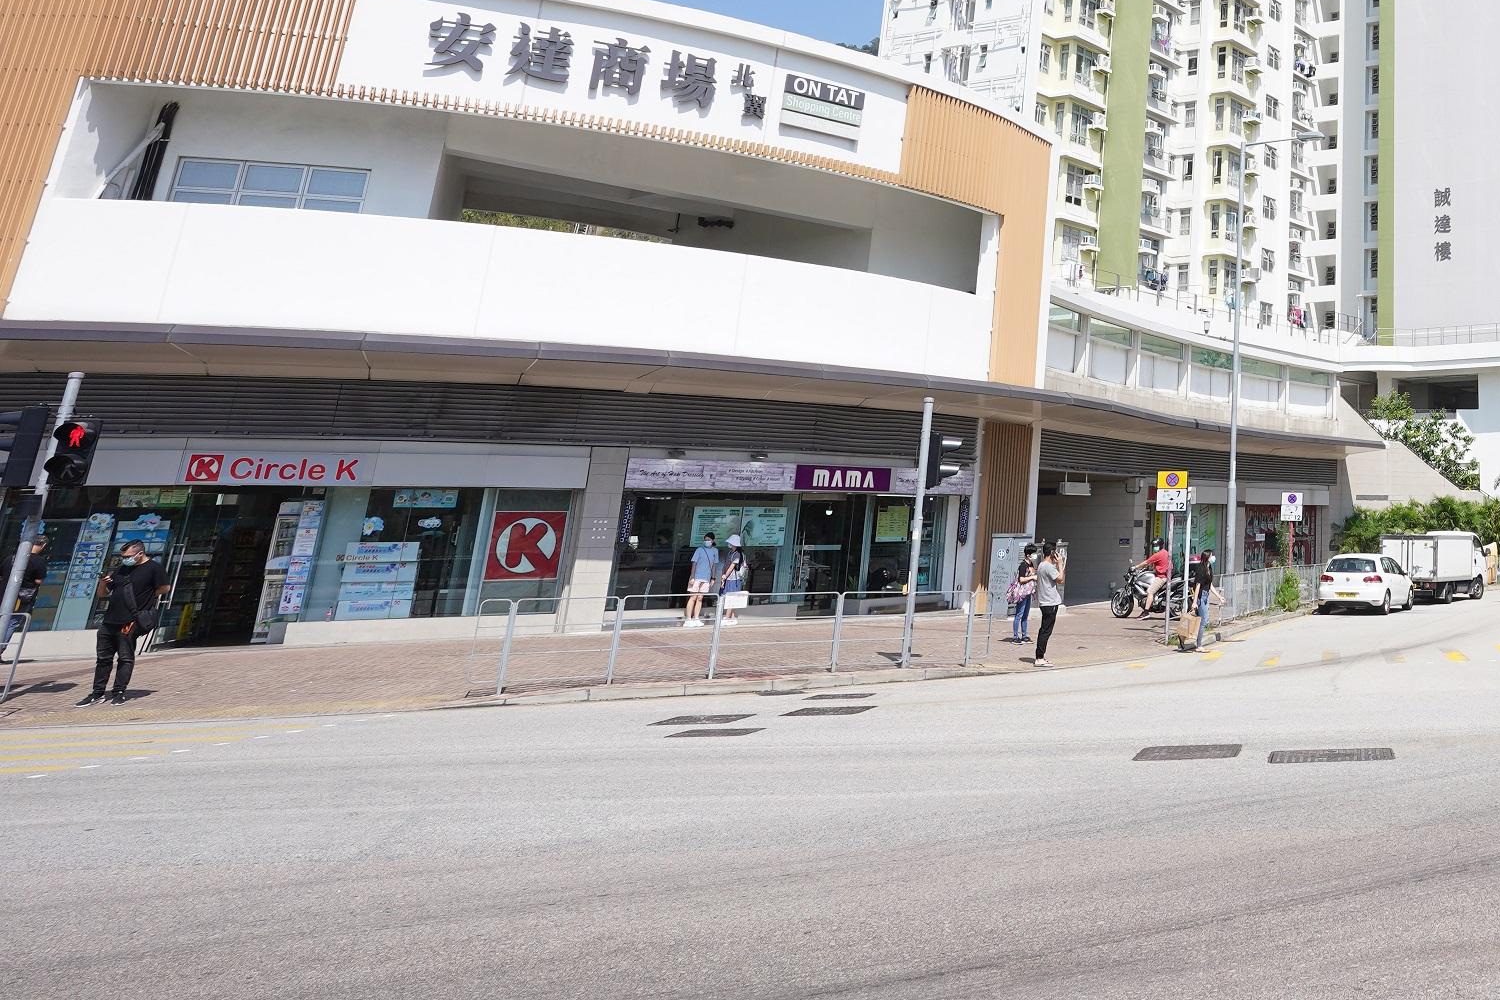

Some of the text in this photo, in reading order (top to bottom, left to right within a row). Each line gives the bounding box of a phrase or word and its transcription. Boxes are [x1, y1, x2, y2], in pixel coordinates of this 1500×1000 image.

[793, 77, 860, 107] ON TAT
[786, 95, 862, 121] Shopping Centre
[230, 457, 326, 480] Circle
[335, 458, 359, 481] K
[812, 469, 875, 489] MAMA
[1176, 490, 1181, 498] 7
[1176, 502, 1185, 510] 12
